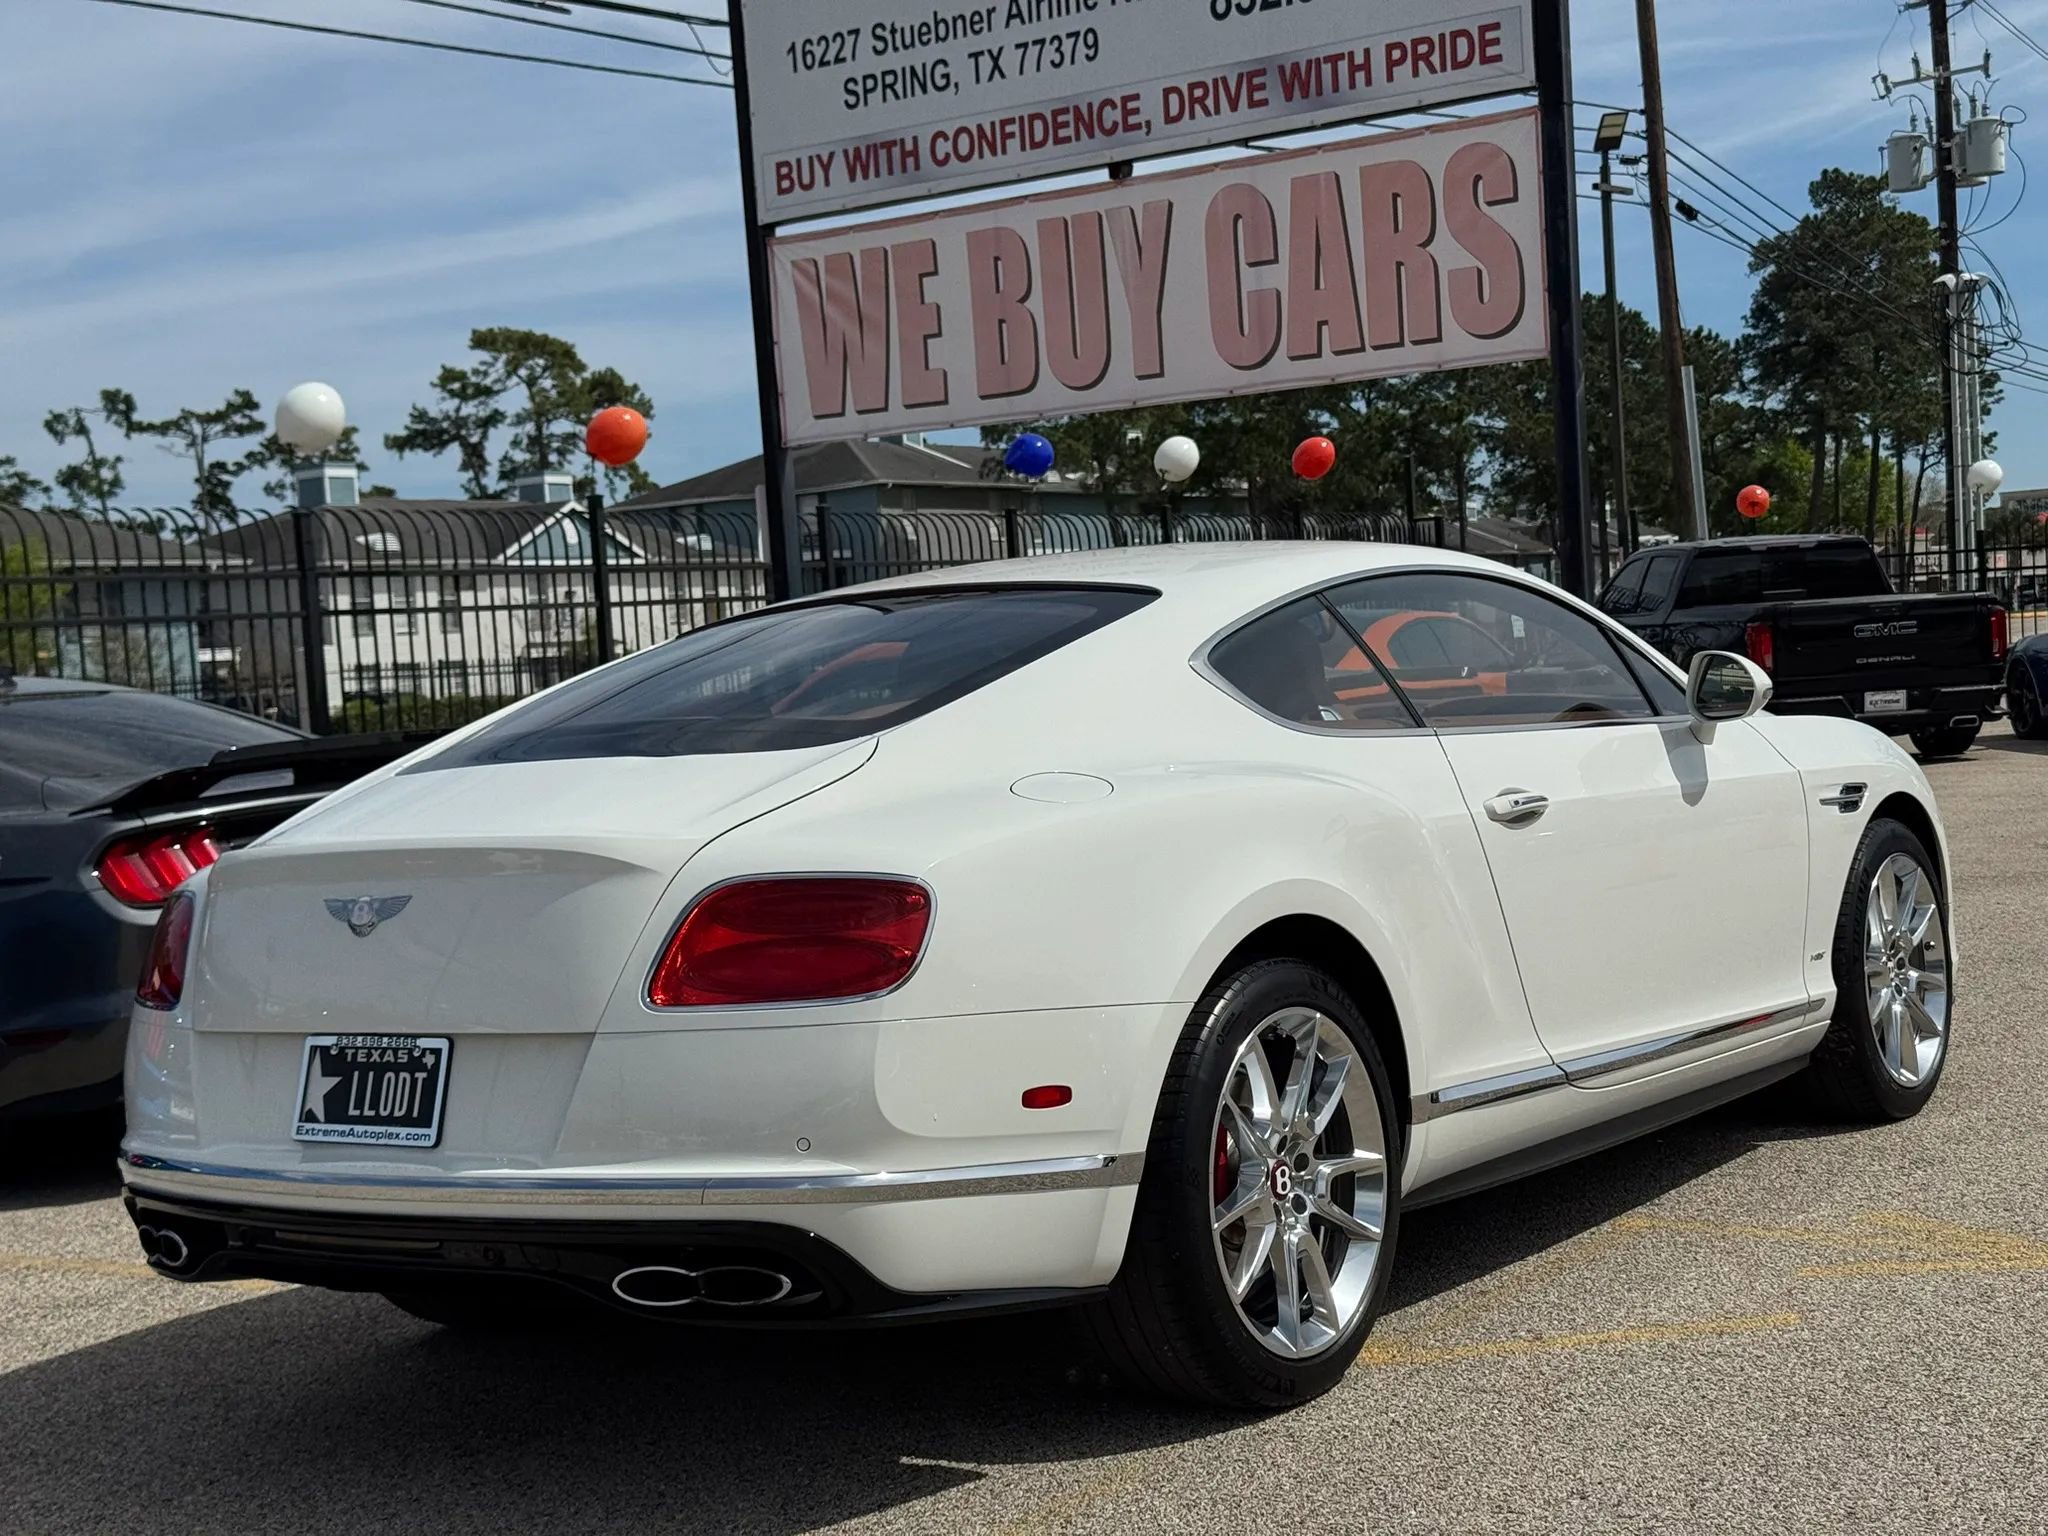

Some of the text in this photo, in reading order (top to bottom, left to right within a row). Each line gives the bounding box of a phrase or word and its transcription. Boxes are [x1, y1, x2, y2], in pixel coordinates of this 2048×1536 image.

[786, 28, 861, 73] 16227
[871, 6, 997, 56] Stuebner
[843, 27, 1099, 110] SPRING, TX 77379
[775, 22, 1503, 196] BUY WITH CONFIDENCE, DRIVE WITH PRIDE
[790, 142, 1525, 418] WE BUY CARS
[1854, 621, 1918, 638] GMC
[345, 1049, 409, 1063] TEXAS
[296, 1125, 431, 1142] ExtremeAutoplex.com
